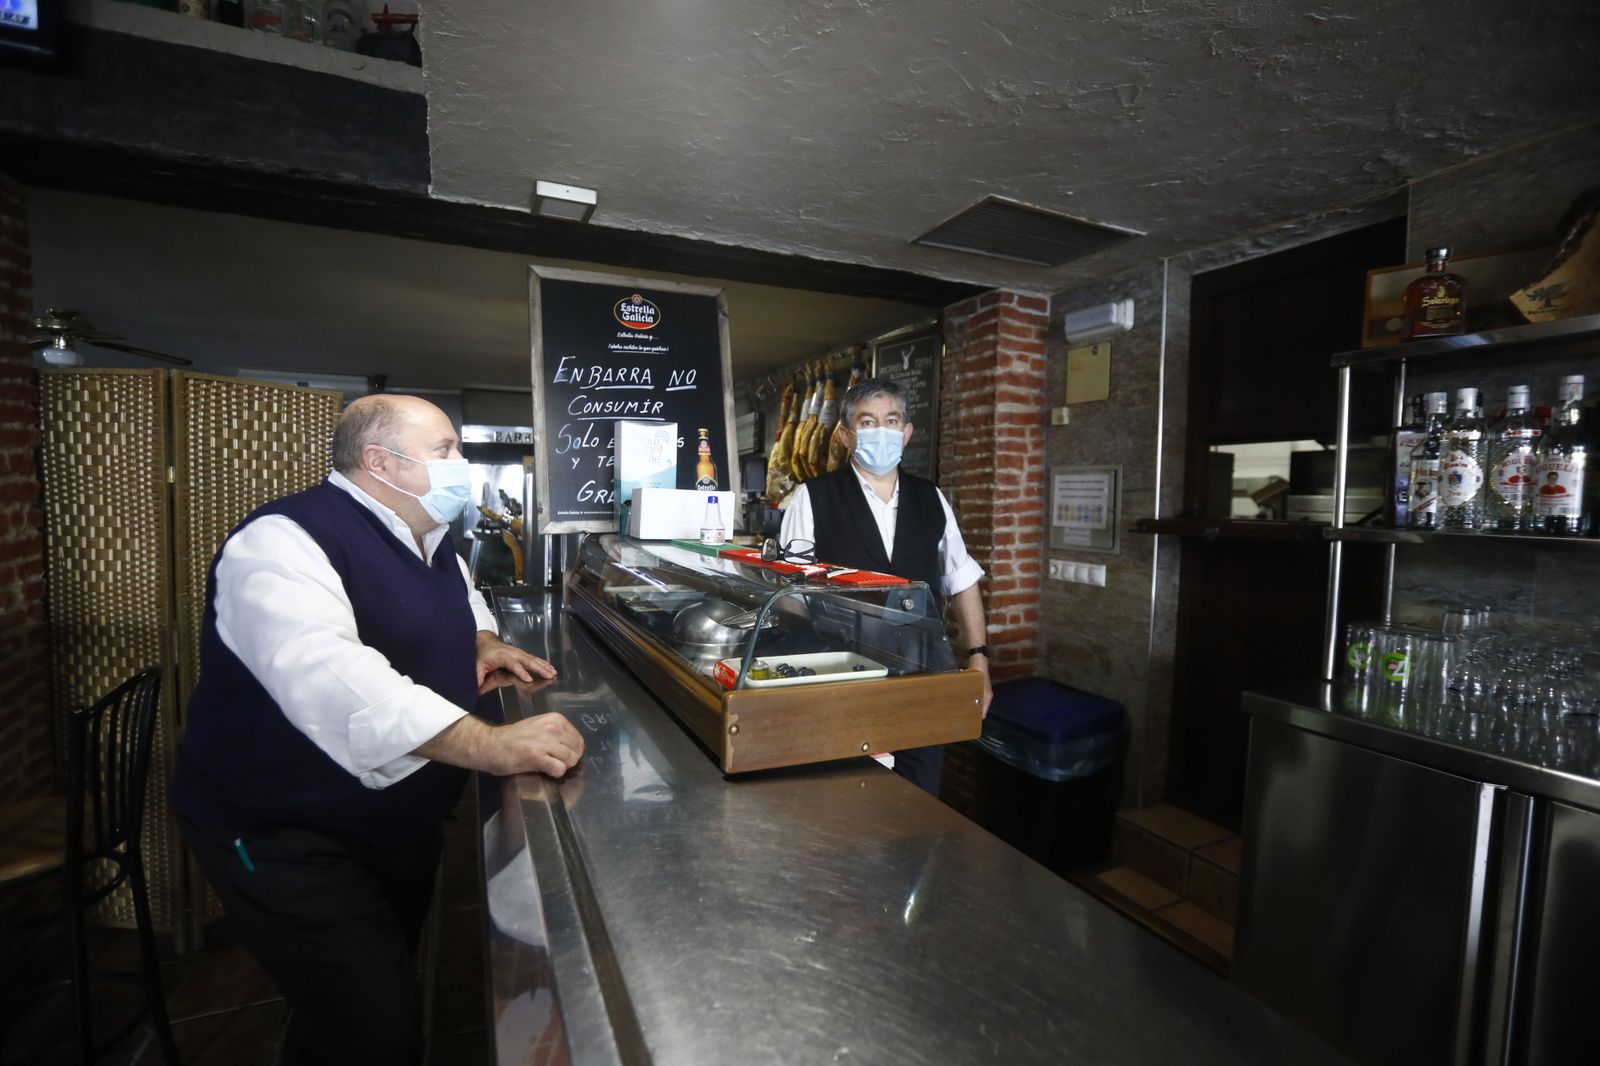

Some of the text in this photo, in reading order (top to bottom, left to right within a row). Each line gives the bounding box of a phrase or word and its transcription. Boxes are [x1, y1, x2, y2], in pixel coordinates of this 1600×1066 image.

[620, 302, 655, 315] Estrella
[622, 311, 654, 323] Galicia
[553, 356, 697, 387] EN BARRA NO
[567, 395, 664, 415] CONSUMIR
[496, 431, 532, 443] BARR
[597, 455, 615, 468] TE
